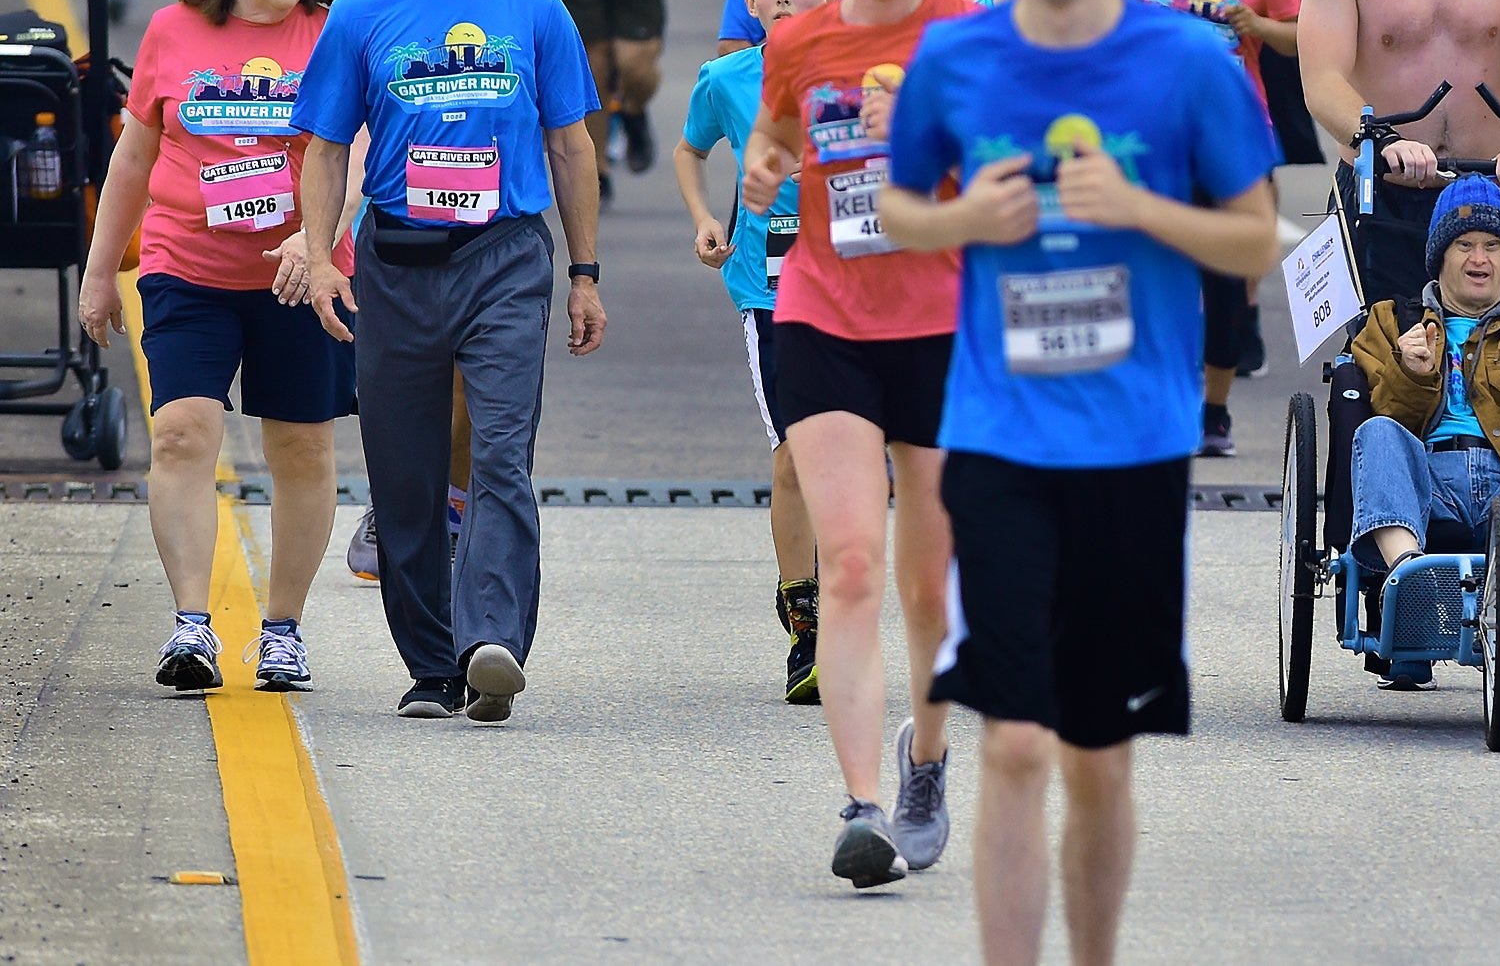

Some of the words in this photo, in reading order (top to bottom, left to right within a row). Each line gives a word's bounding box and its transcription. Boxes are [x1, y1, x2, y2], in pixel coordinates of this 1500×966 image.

[399, 83, 433, 96] GATE
[437, 79, 478, 93] RIVER
[481, 77, 511, 90] RUN
[186, 106, 222, 118] GATE
[225, 106, 269, 117] RIVER
[272, 107, 293, 118] RU
[412, 151, 439, 160] GATE
[439, 152, 471, 162] RIVER
[472, 153, 494, 162] RUN
[203, 166, 228, 178] GATE
[228, 161, 259, 174] RIVER
[260, 156, 282, 168] RUN
[223, 197, 277, 221] 14926
[426, 190, 481, 209] 14927
[770, 219, 796, 228] GATE
[1313, 300, 1332, 328] BOB
